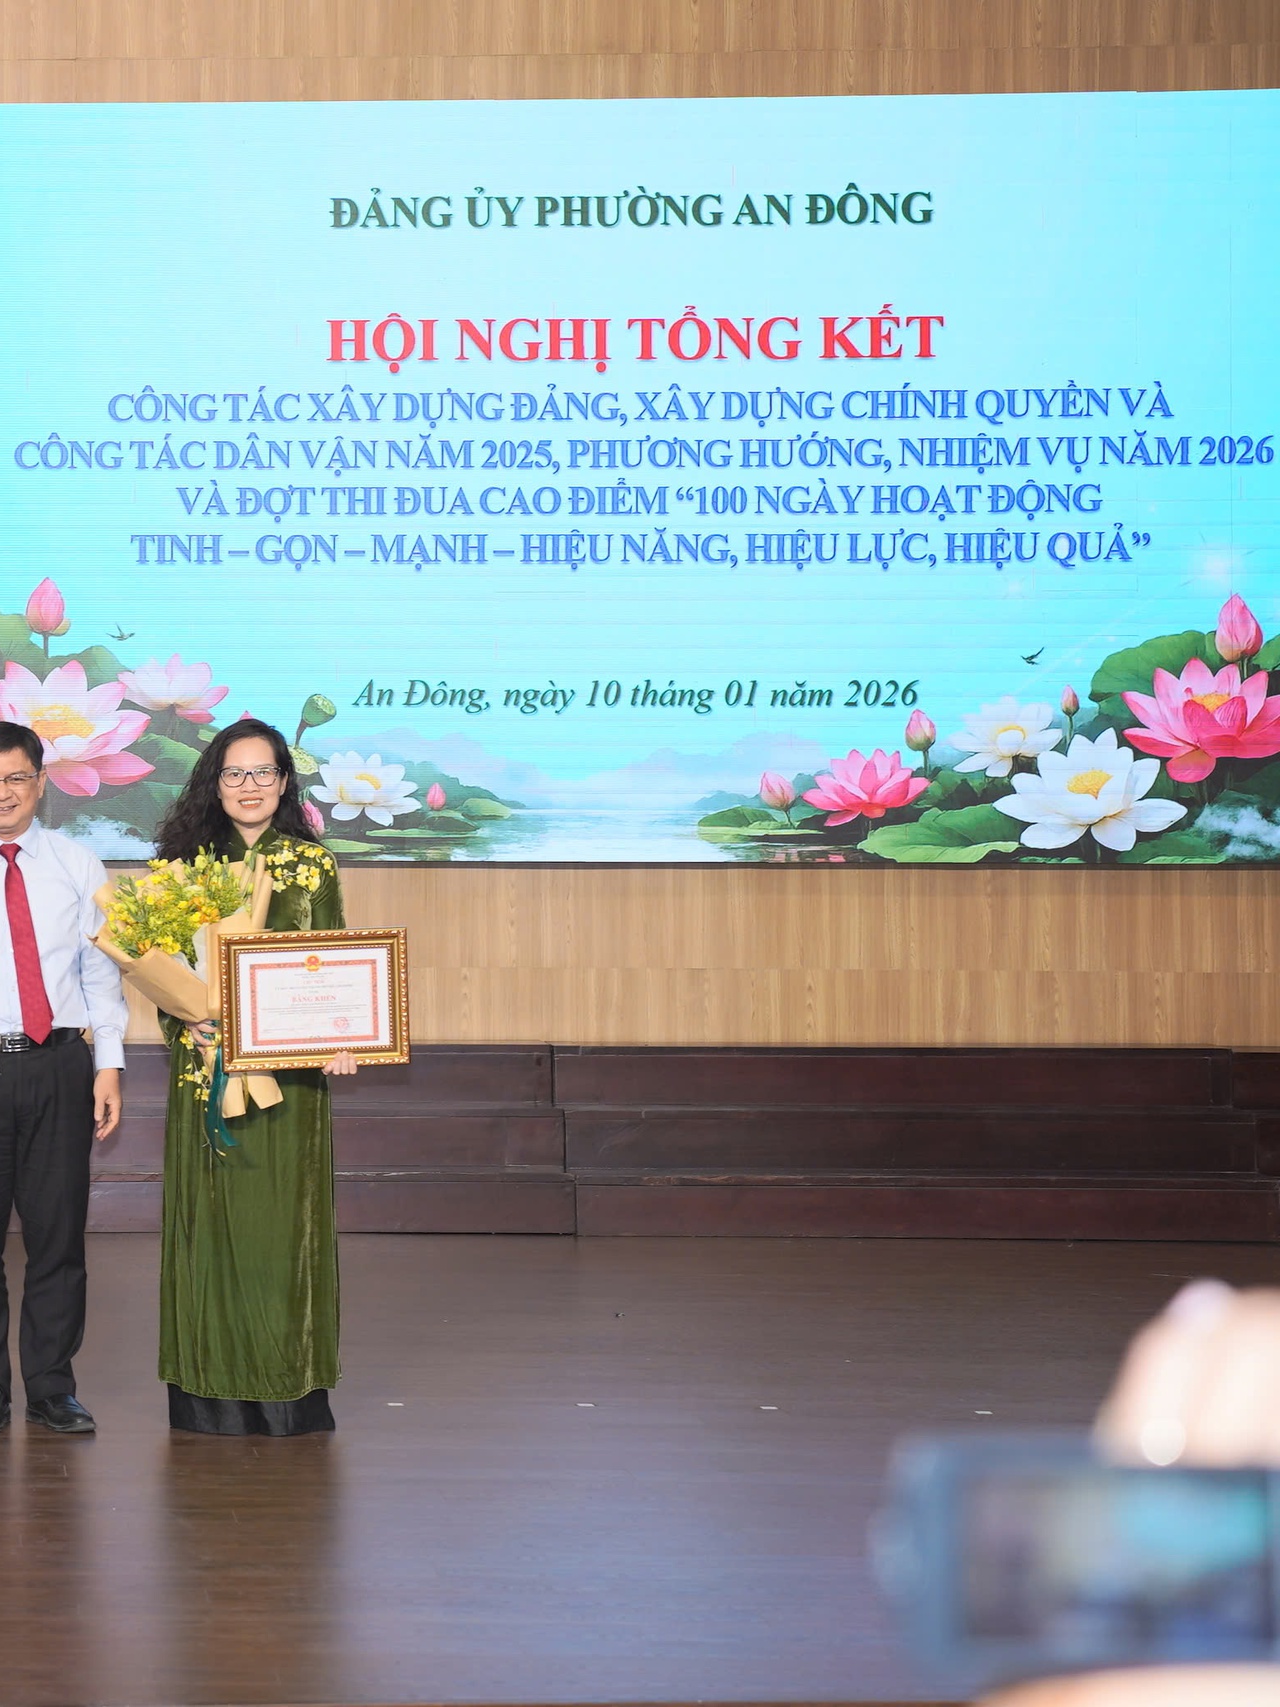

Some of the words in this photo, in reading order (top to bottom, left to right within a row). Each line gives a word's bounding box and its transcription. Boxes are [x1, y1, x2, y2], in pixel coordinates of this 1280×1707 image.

[329, 187, 453, 230] ĐẢNG
[465, 186, 523, 229] ỦY
[534, 185, 724, 228] PHƯỜNG
[732, 193, 793, 226] AN
[805, 182, 934, 226] ĐÔNG
[326, 312, 439, 374] HỘI
[454, 318, 612, 374] NGHỊ
[627, 304, 802, 362] TỔNG
[819, 303, 945, 360] KẾT
[108, 385, 218, 422] CÔNG
[223, 386, 300, 422] TÁC
[307, 384, 387, 422] XÂY
[393, 388, 505, 429] DỰNG
[510, 383, 627, 426] ĐẢNG,
[634, 383, 716, 421] XÂY
[721, 387, 835, 428] DỰNG
[841, 382, 968, 420] CHÍNH
[975, 380, 1112, 425] QUYỀN
[1117, 381, 1174, 418] VÀ
[14, 432, 124, 469] CÔNG
[129, 433, 206, 469] TÁC
[213, 432, 293, 469] DÂN
[298, 436, 378, 477] VẬN
[385, 433, 475, 469] NĂM
[481, 440, 560, 474] 2025,
[567, 435, 733, 468] PHƯƠNG
[739, 431, 892, 473] HƯỚNG,
[898, 433, 1030, 474] NHIỆM
[1036, 436, 1090, 474] VỤ
[1099, 429, 1192, 467] NĂM
[1198, 435, 1274, 466] 2026
[176, 480, 230, 515] VÀ
[236, 484, 315, 523] ĐỢT
[321, 486, 387, 515] THI
[394, 487, 475, 515] ĐUA
[479, 486, 561, 515] CAO
[568, 478, 669, 515] ĐIỂM
[676, 486, 747, 514] “100
[754, 478, 865, 515] NGÀY
[870, 485, 983, 521] HOẠT
[988, 480, 1103, 521] ĐỘNG
[131, 534, 223, 563] TINH
[255, 534, 338, 571] GỌN
[371, 533, 488, 571] MẠNH
[520, 530, 614, 570] HIỆU
[620, 528, 738, 568] NĂNG,
[745, 529, 840, 570] HIỆU
[847, 528, 937, 569] LỰC,
[944, 528, 1040, 569] HIỆU
[1047, 522, 1151, 567] QUẢ”
[352, 679, 395, 707] An
[402, 680, 490, 713] Đông,
[503, 680, 576, 714] ngày
[586, 680, 621, 707] 10
[631, 679, 715, 714] tháng
[725, 680, 758, 707] 01
[770, 681, 834, 708] năm
[844, 679, 920, 707] 2026
